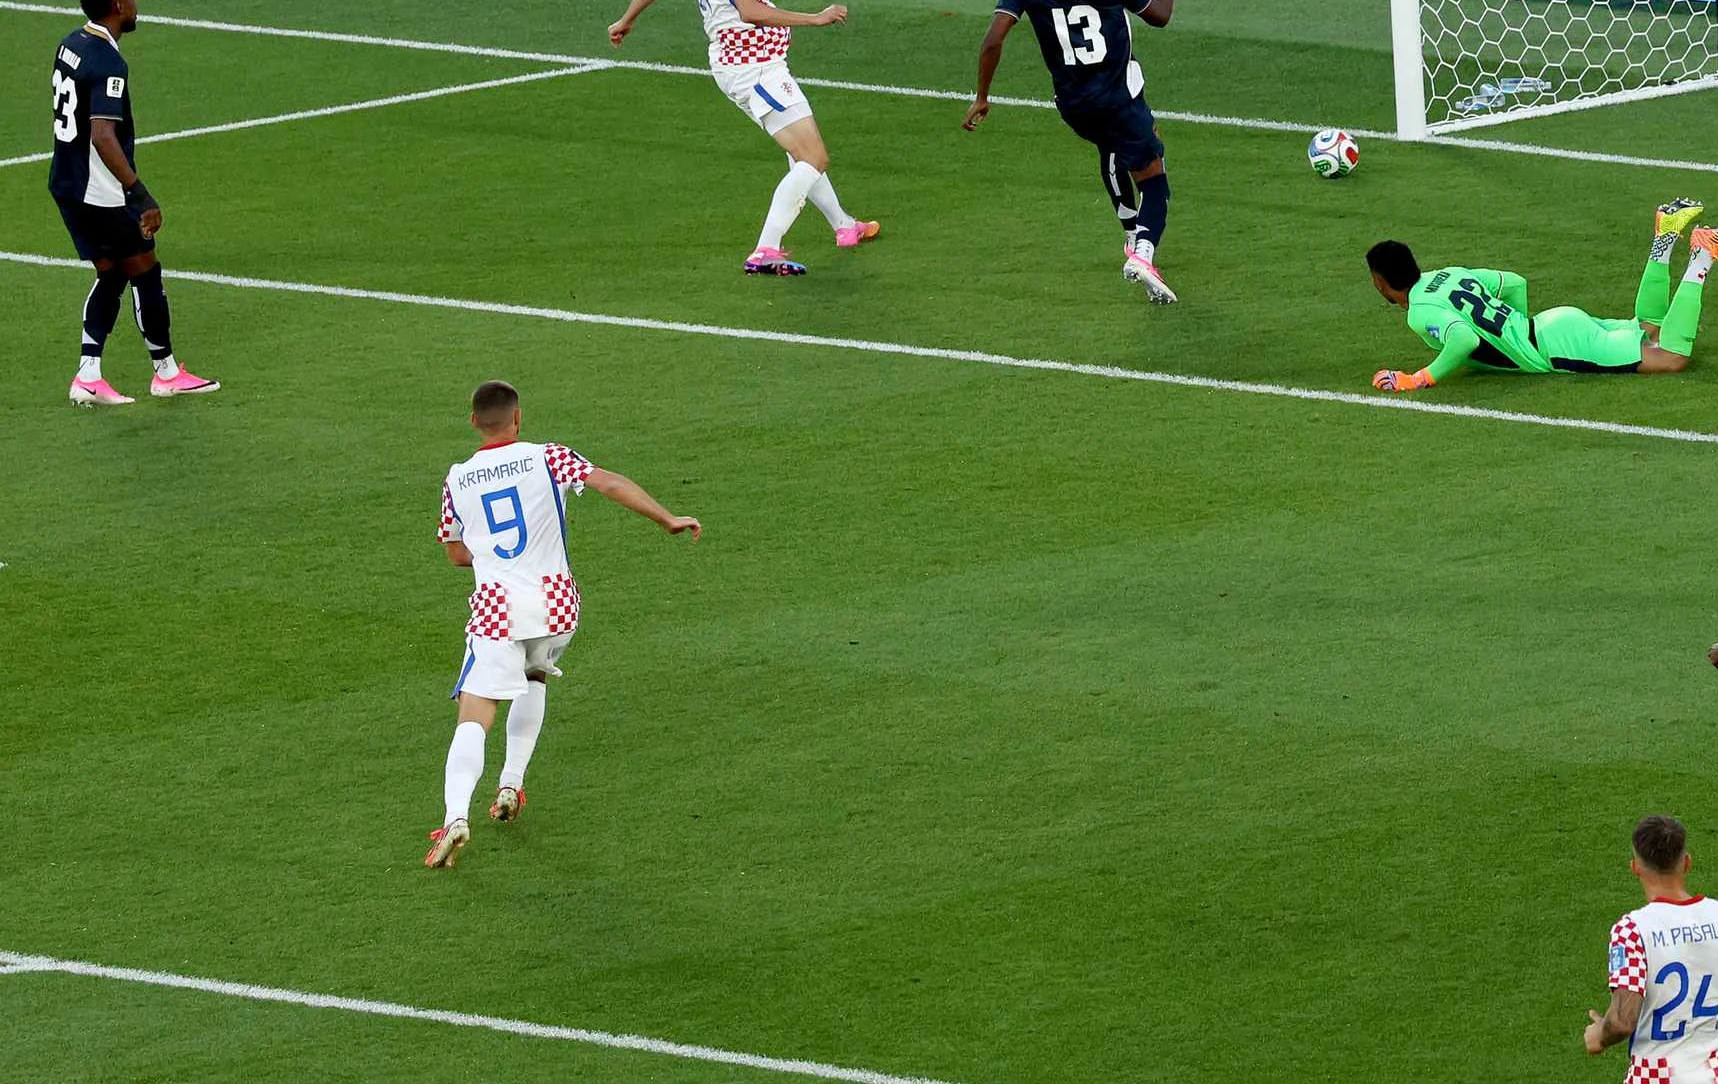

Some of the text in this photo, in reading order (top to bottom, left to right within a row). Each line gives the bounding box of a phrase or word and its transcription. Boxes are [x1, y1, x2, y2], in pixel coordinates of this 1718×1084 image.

[1051, 4, 1108, 67] 13
[54, 68, 79, 144] 23
[480, 485, 528, 560] 9
[1652, 931, 1669, 948] M.
